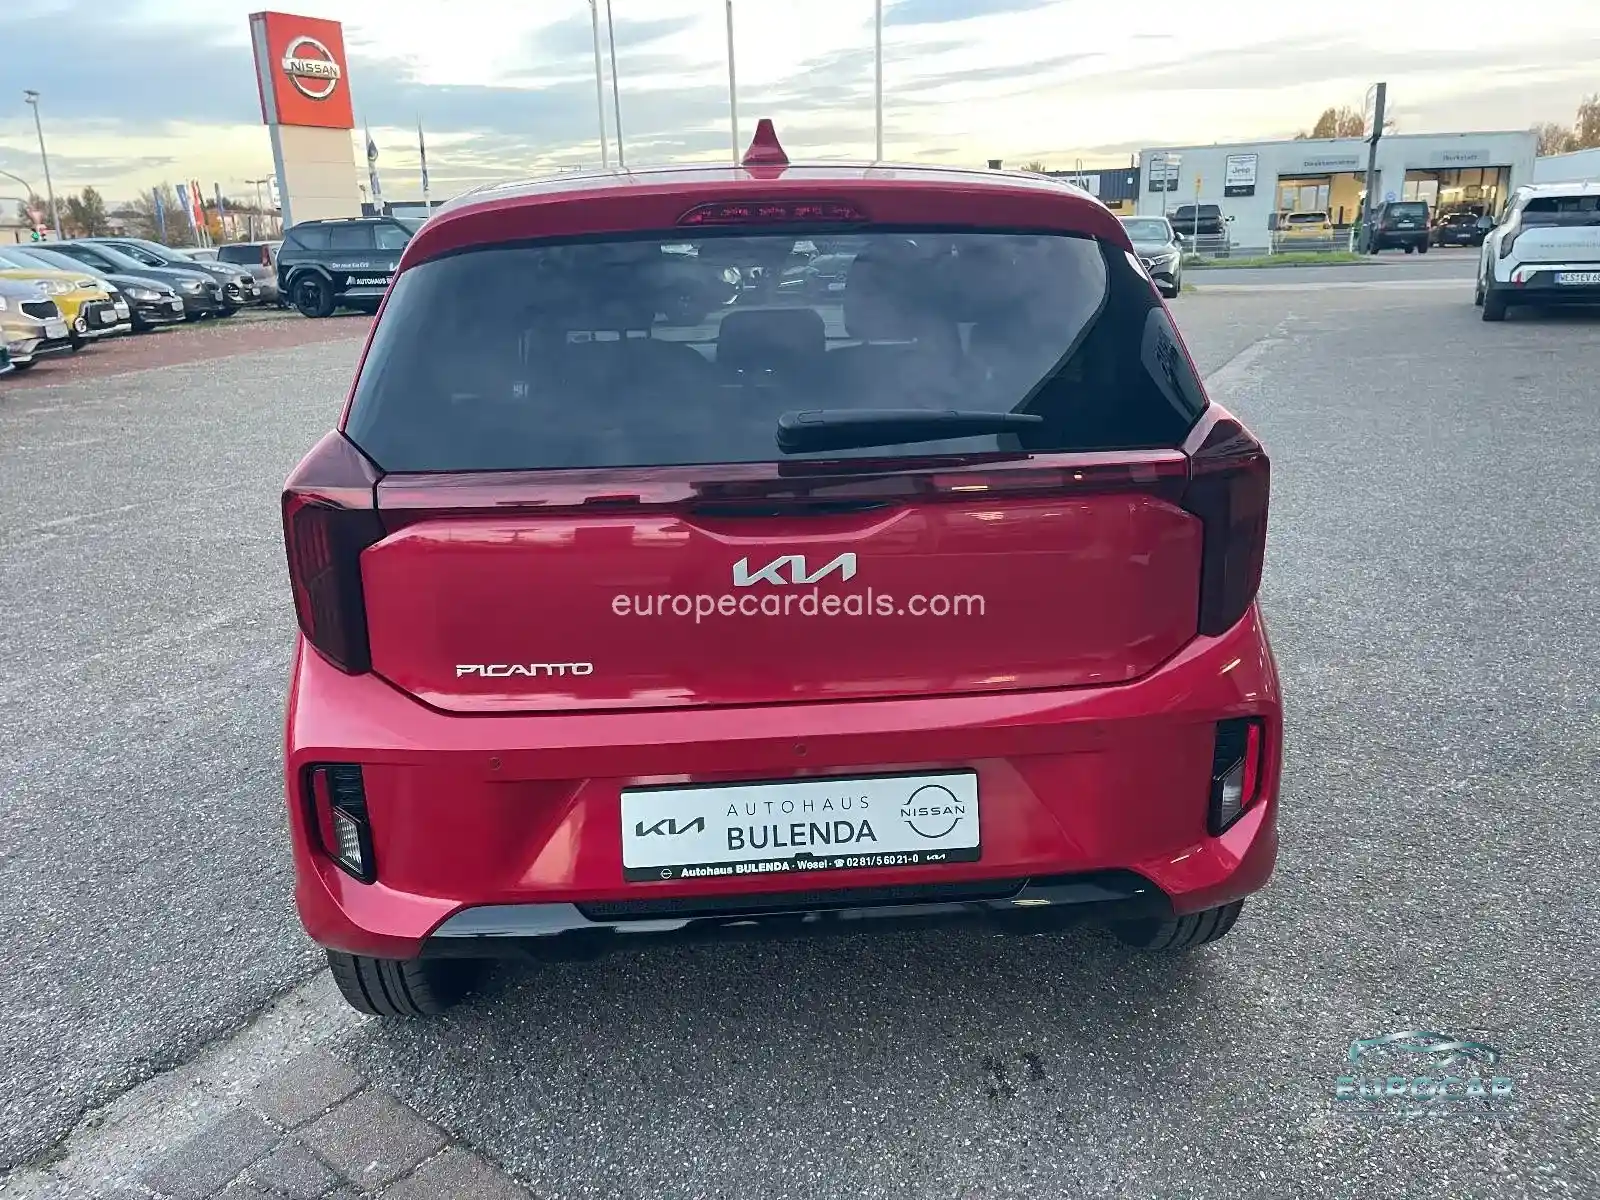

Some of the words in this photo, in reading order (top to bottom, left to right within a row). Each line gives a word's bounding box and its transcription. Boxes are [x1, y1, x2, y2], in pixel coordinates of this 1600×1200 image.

[290, 61, 338, 77] NISSAN
[1232, 166, 1251, 175] Jeep
[733, 552, 857, 587] KIA
[455, 662, 594, 678] PICANTO
[726, 796, 870, 817] AUTOHAUS
[900, 805, 966, 817] NISSAN
[635, 816, 705, 837] KIA
[727, 819, 878, 851] BULENDA
[680, 865, 733, 878] Autohaus
[735, 861, 790, 874] BULENDA
[796, 859, 828, 870] Wesel
